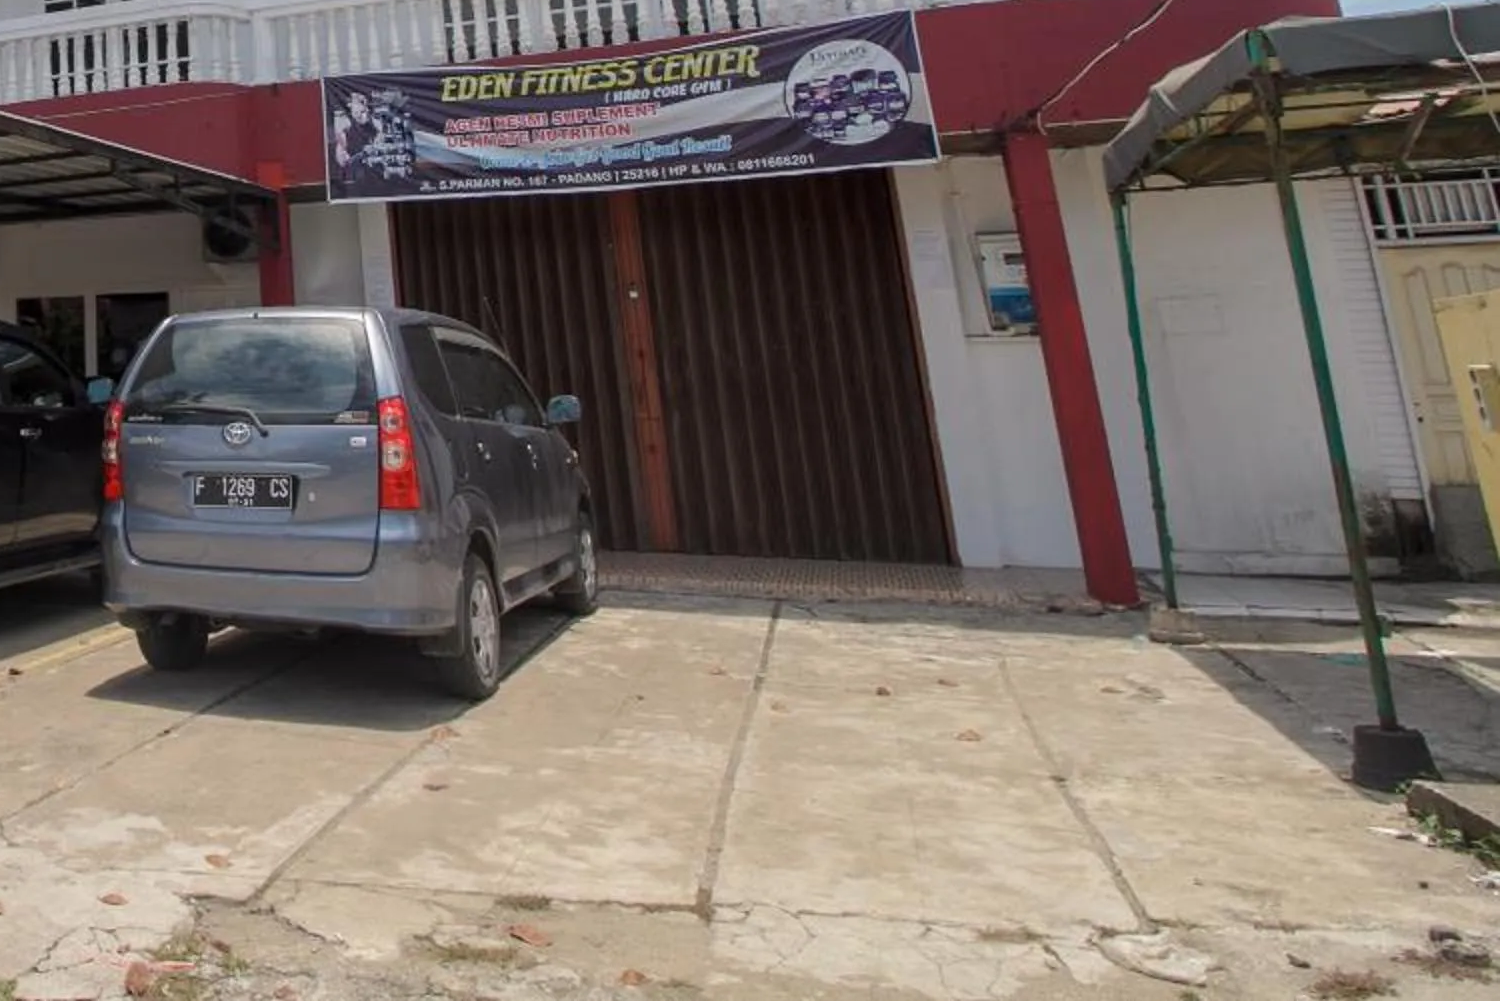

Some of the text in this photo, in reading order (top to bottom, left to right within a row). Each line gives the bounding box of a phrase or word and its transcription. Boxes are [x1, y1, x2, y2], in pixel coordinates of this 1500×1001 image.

[441, 45, 761, 102] EDEN FITNESS CENTER
[559, 171, 612, 184] PADANG
[196, 476, 289, 498] F 1269 CS
